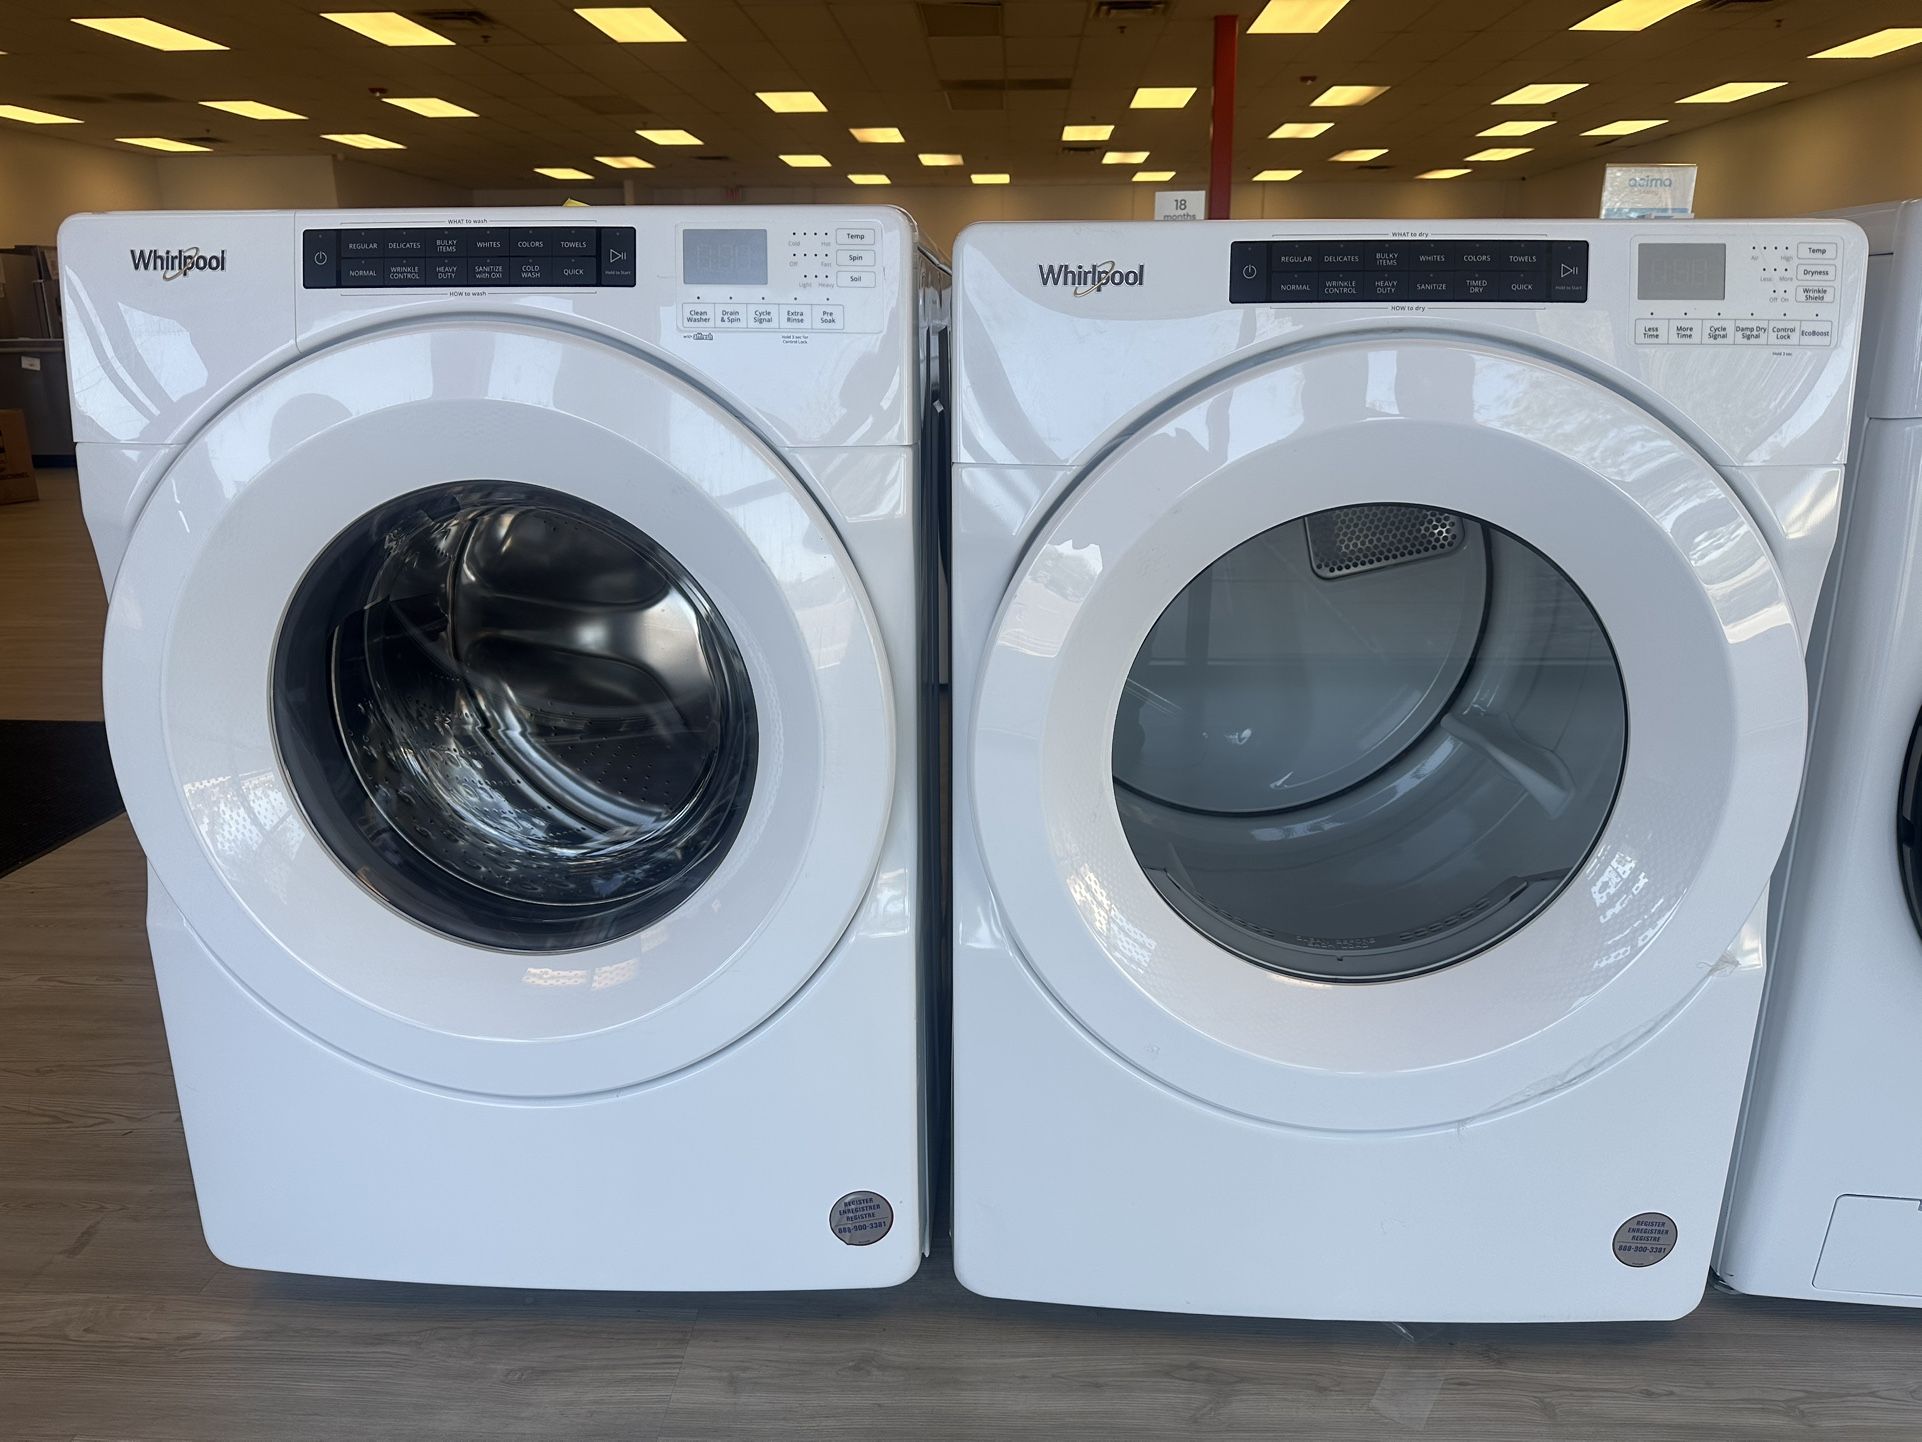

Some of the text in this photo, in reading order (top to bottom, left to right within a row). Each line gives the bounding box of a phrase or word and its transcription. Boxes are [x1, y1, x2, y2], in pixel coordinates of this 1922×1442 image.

[1174, 199, 1187, 211] 18
[1808, 247, 1826, 255] Temp
[848, 254, 863, 262] Spin
[1509, 255, 1537, 263] TOWELS
[130, 249, 226, 277] Whirlpool
[563, 268, 584, 276] QUICK
[1803, 269, 1829, 277] Dryness
[1039, 264, 1144, 292] Whirlpool
[1469, 286, 1483, 294] DRY
[1511, 283, 1533, 291] QUICK
[754, 310, 772, 318] Cycle
[727, 316, 741, 324] Spin
[754, 316, 773, 324] Signal
[1709, 326, 1727, 334] Cycle
[1735, 326, 1767, 334] Damp Dry
[1772, 326, 1796, 334] Control
[1643, 332, 1659, 340] Time
[1676, 332, 1693, 340] Time
[1708, 332, 1728, 340] Signal
[1742, 332, 1761, 340] Signal
[844, 1197, 874, 1208] REGISTER
[839, 1204, 881, 1216] ENREGISTRER
[846, 1212, 876, 1222] REGISTRE
[1636, 1220, 1666, 1228] REGISTER
[1628, 1227, 1669, 1235] ENREGISTRER
